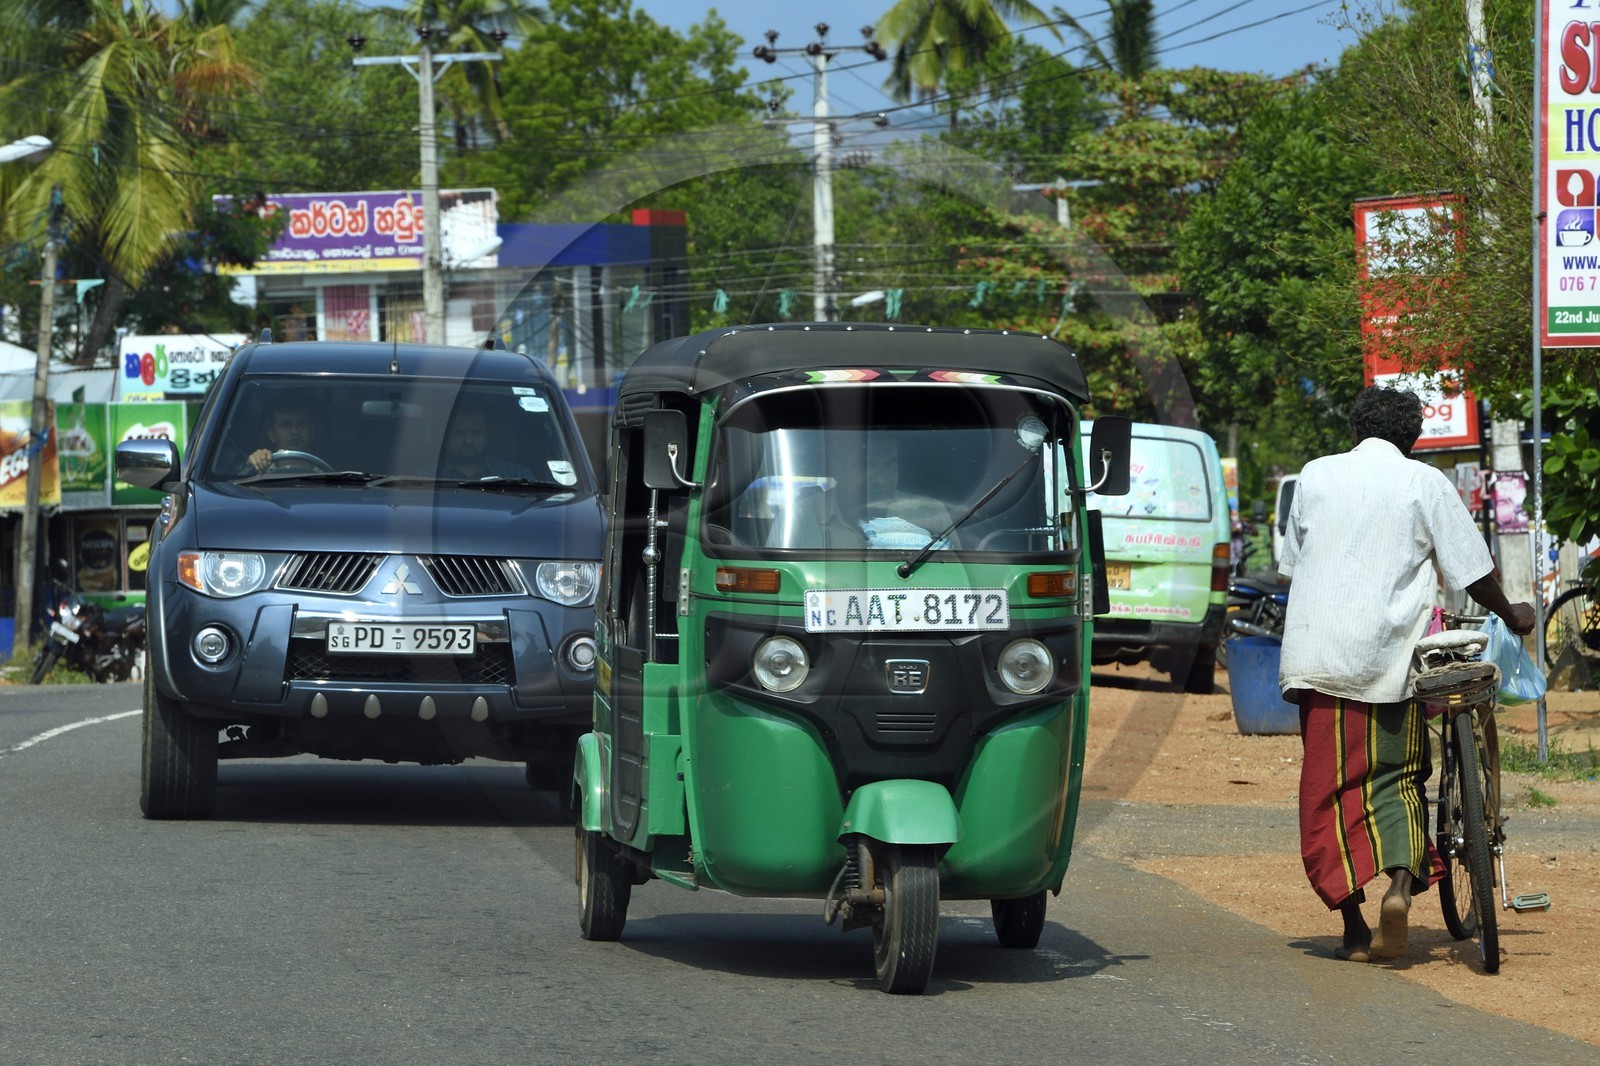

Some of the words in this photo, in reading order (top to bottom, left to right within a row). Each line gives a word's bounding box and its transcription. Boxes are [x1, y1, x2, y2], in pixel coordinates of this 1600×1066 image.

[1560, 20, 1600, 95] S
[1560, 276, 1584, 292] 076
[1555, 311, 1583, 324] 22nd
[845, 595, 907, 626] AAT
[923, 594, 1004, 625] 8172
[354, 627, 384, 648] PD
[413, 628, 472, 650] 9593
[893, 670, 922, 687] RE
